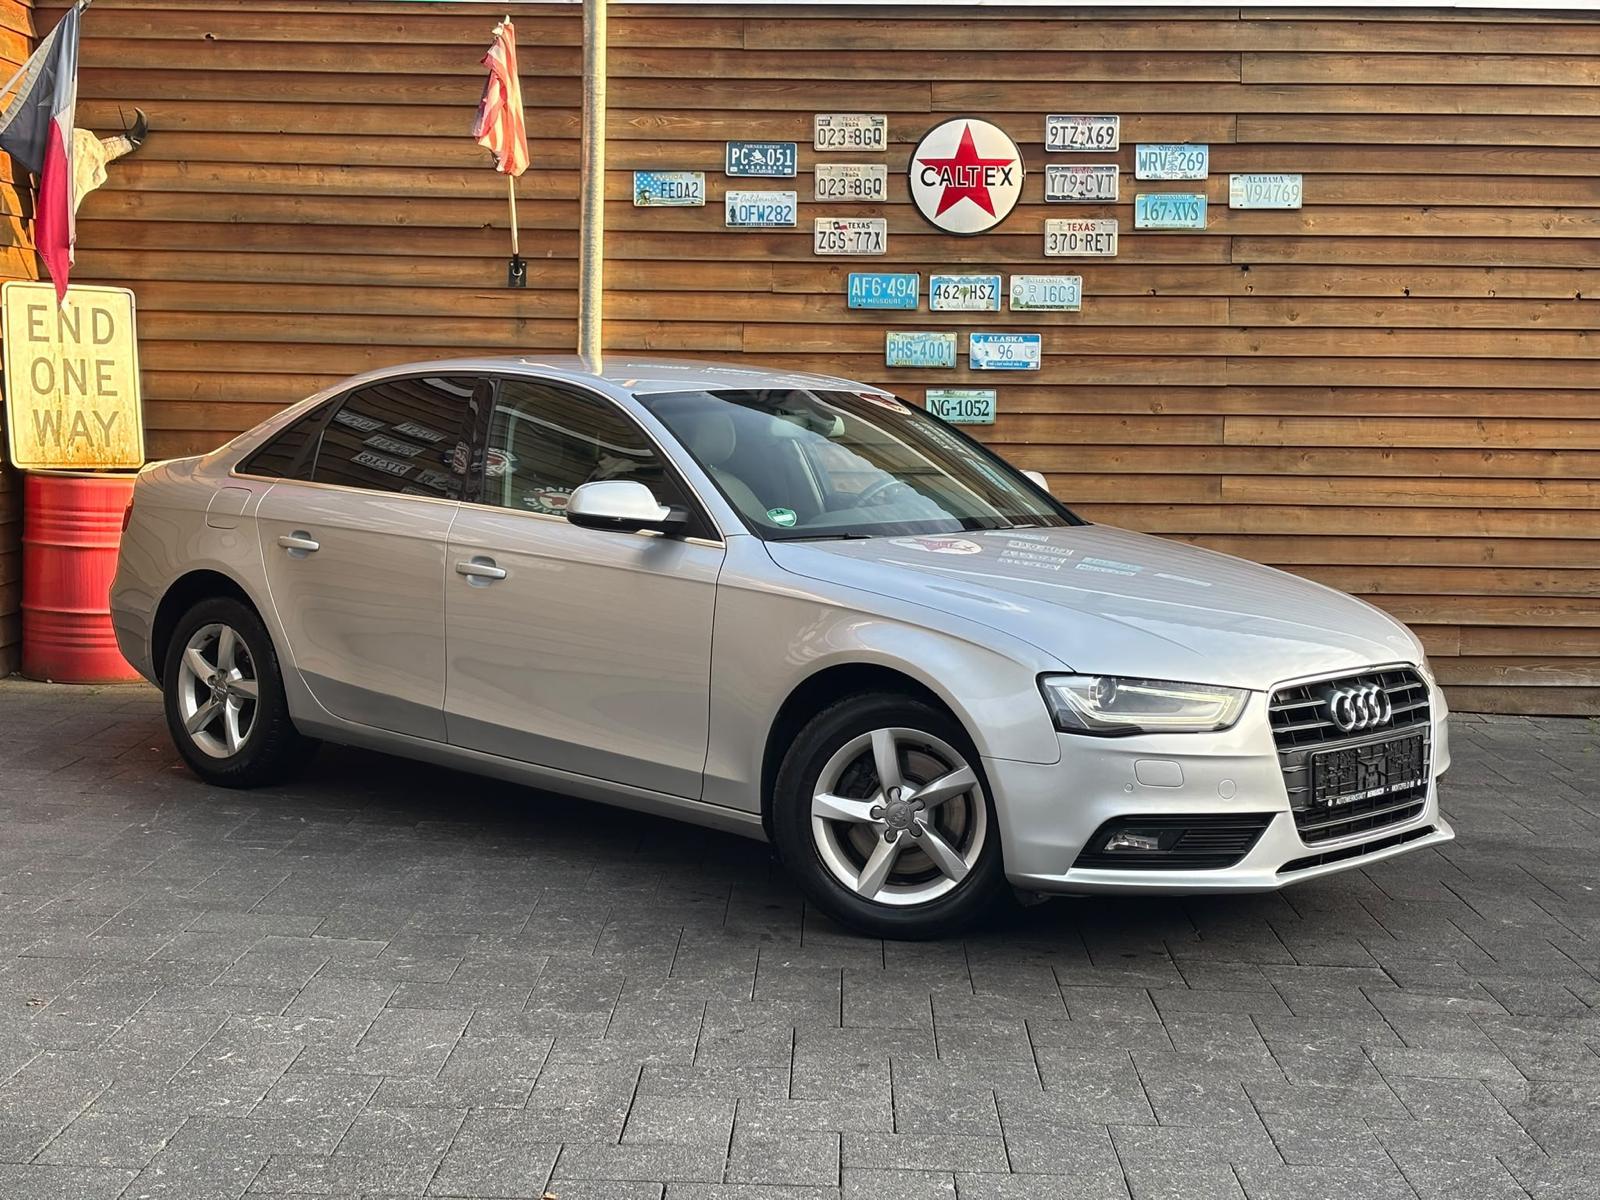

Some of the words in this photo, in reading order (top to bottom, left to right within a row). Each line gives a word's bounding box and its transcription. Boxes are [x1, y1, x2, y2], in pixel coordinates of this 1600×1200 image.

[731, 148, 749, 164] PC
[767, 149, 792, 165] 051
[1178, 152, 1204, 171] 269
[920, 166, 1013, 187] CALTEX
[1245, 184, 1300, 203] V94769
[1067, 223, 1096, 232] TEXAS
[934, 284, 960, 300] 462
[970, 284, 995, 300] HSZ
[27, 304, 114, 345] END
[988, 335, 1024, 343] ALASKA
[998, 344, 1013, 360] 96
[31, 357, 118, 396] ONE
[931, 399, 990, 417] NG-1052
[33, 409, 119, 447] WAY
